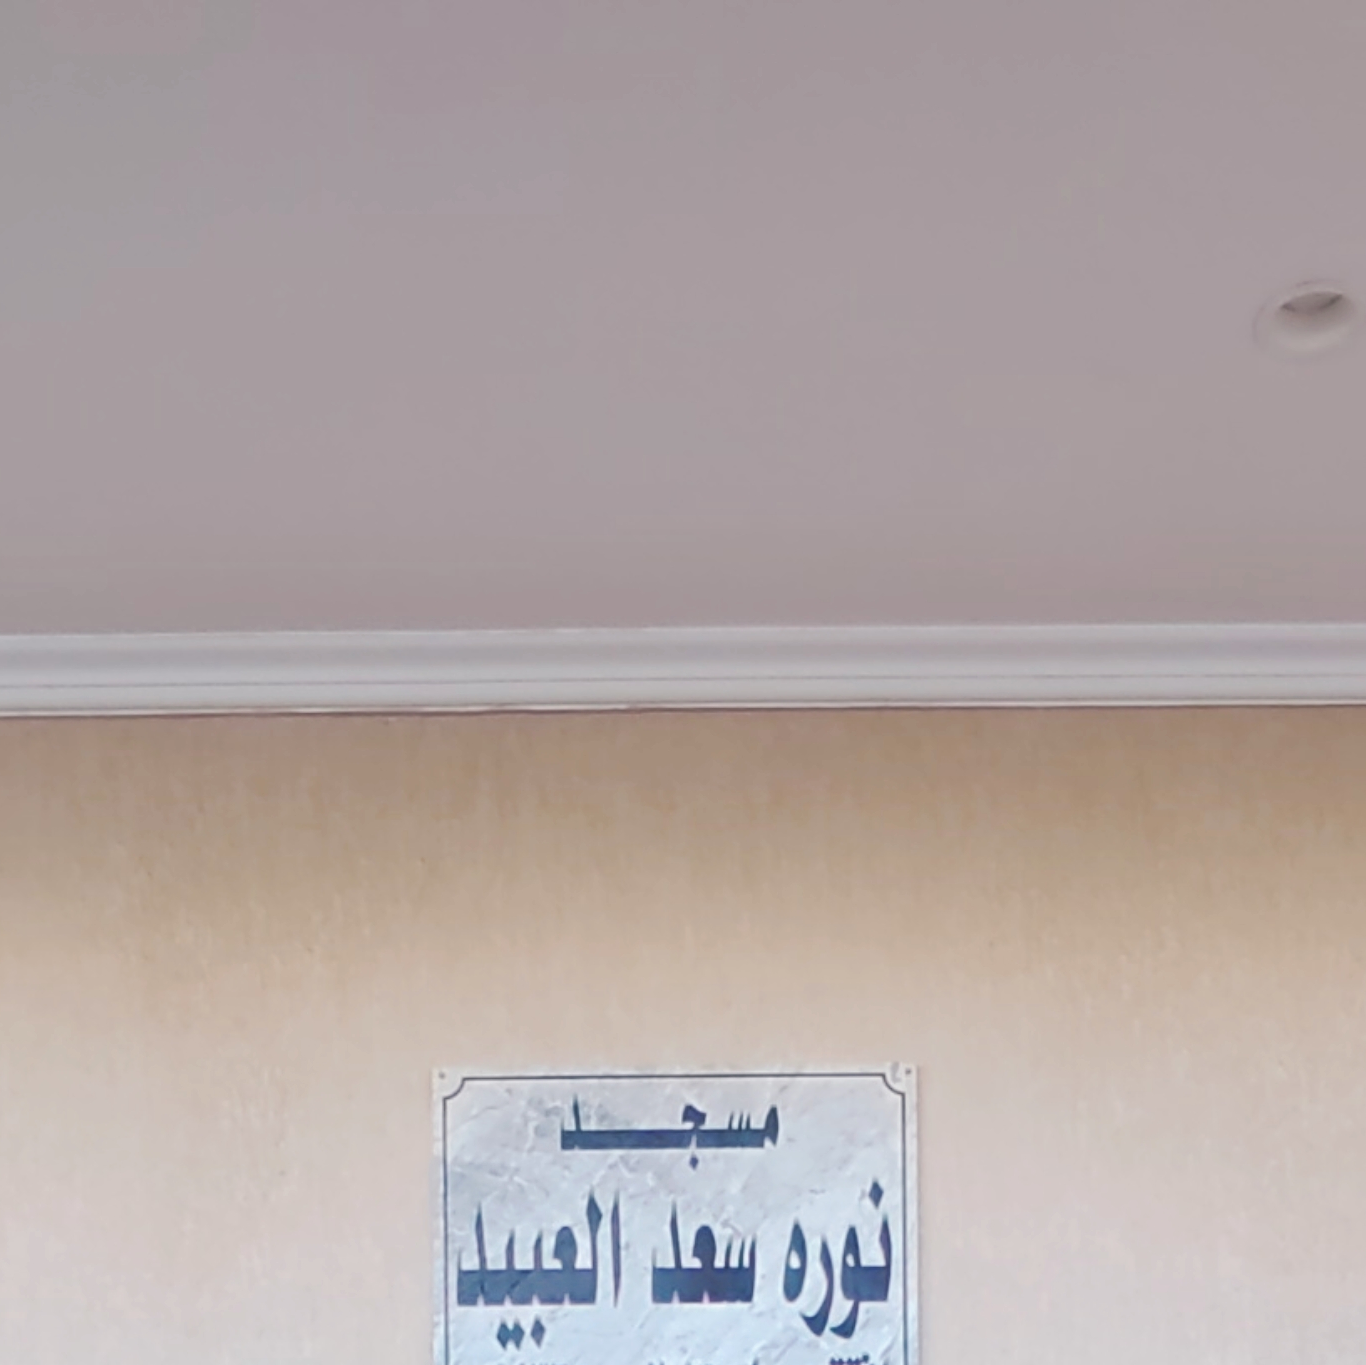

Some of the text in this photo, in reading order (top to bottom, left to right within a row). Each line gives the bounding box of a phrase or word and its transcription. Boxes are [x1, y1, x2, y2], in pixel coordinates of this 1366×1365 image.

[560, 1093, 779, 1170] مسجد
[456, 1178, 893, 1350] نوره سعد العبيد
